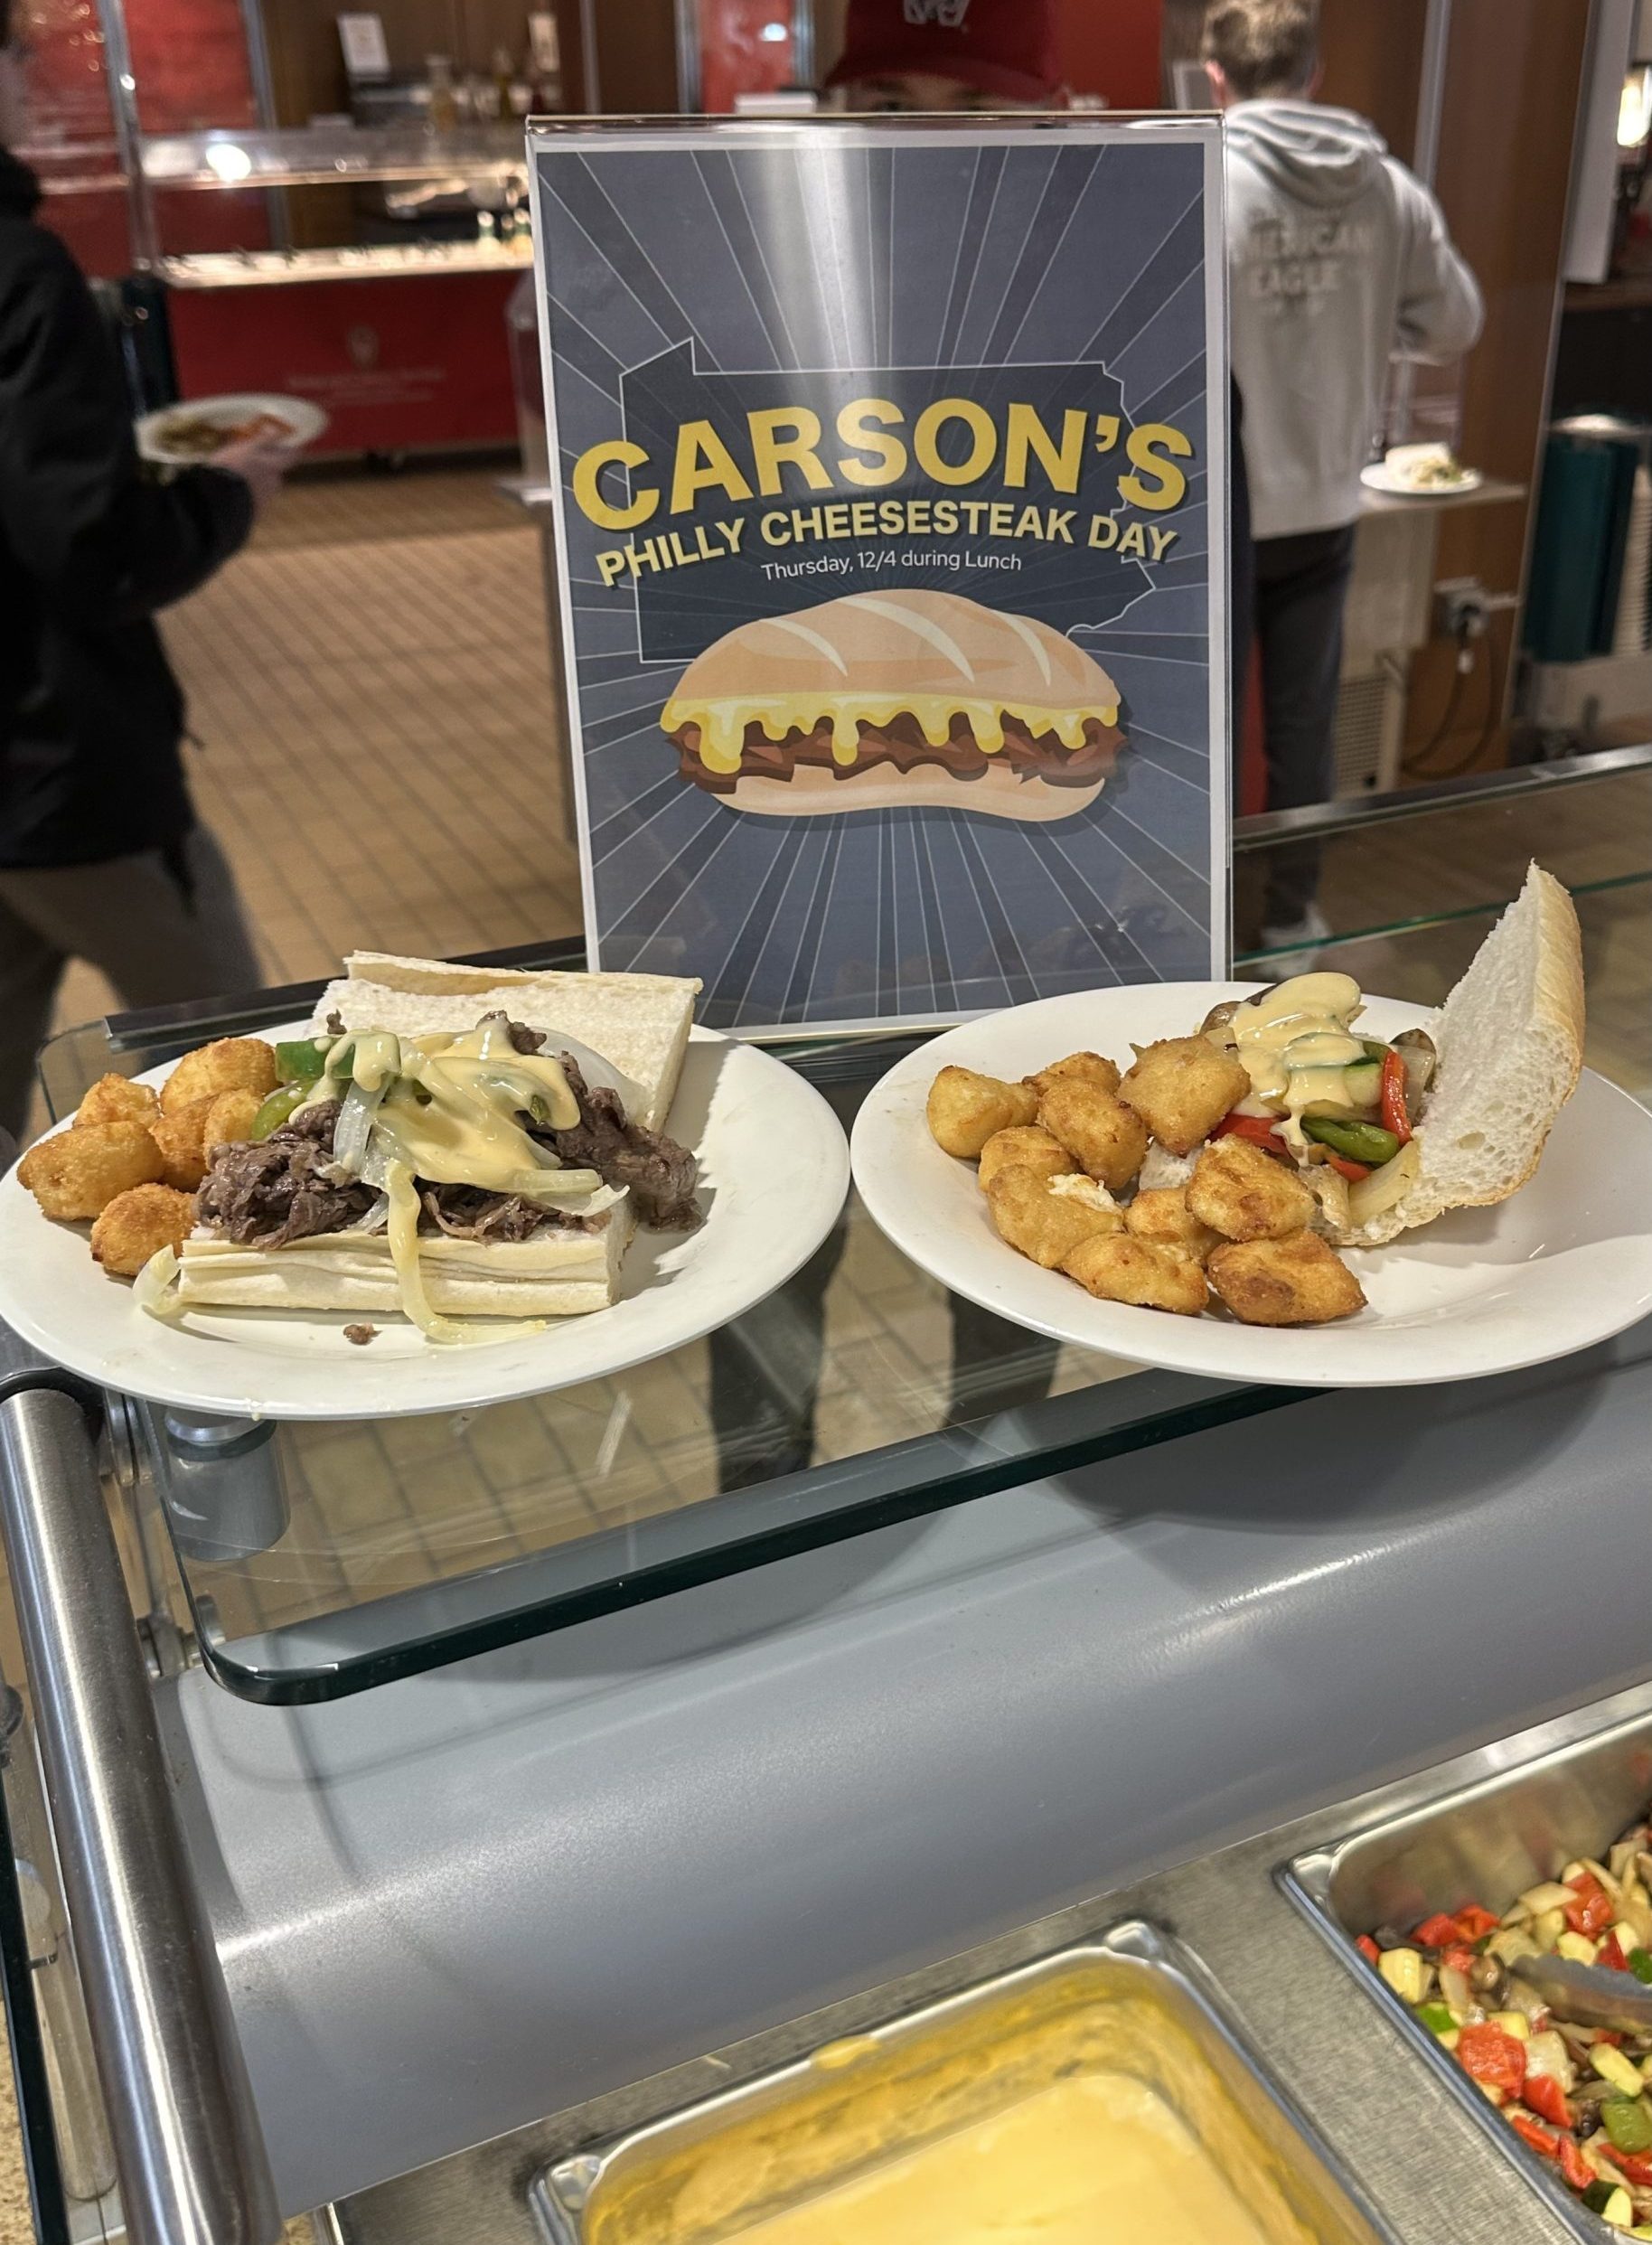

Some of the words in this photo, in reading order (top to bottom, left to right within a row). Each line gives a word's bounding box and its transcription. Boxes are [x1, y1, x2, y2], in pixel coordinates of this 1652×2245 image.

[572, 399, 1194, 531] CARSON'S
[596, 518, 745, 587] PHILLY
[760, 501, 1075, 546] CHEESESTEAK
[1088, 516, 1178, 562] DAY
[760, 555, 854, 580] Thursday,
[857, 550, 897, 573] 12/4
[901, 550, 961, 571] during
[965, 550, 1022, 570] Lunch
